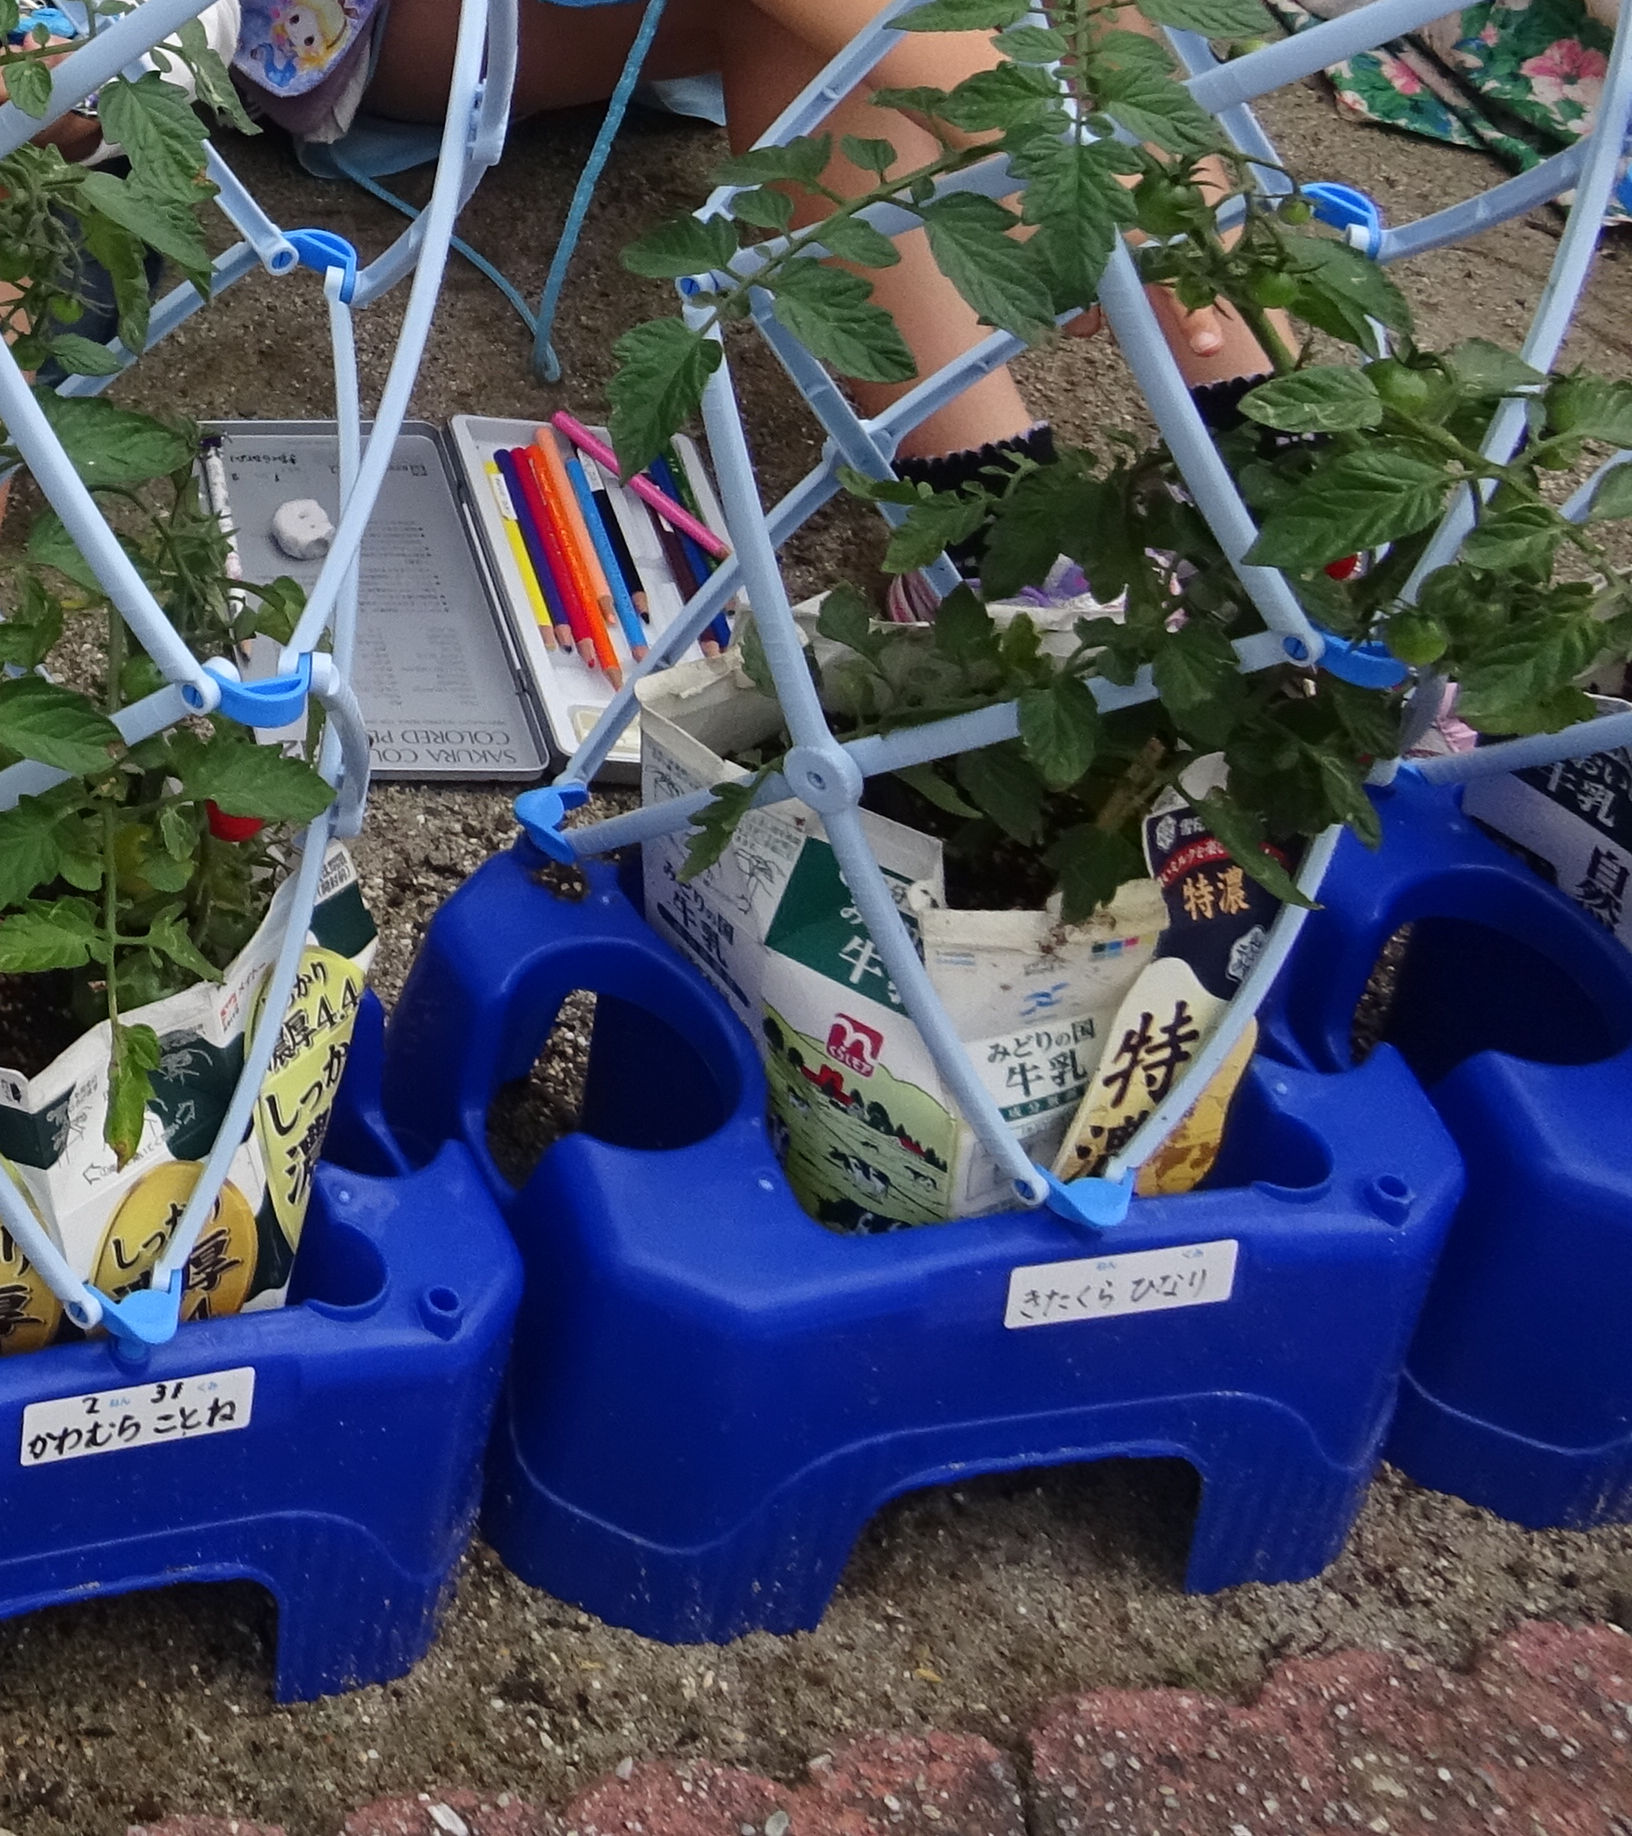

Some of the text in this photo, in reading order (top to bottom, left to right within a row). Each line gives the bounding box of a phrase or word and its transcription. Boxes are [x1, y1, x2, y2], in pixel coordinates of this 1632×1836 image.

[400, 730, 510, 746] COLORED
[425, 749, 517, 764] SAKURA
[1182, 865, 1251, 922] 特濃
[987, 1017, 1095, 1063] みどりの国
[1005, 1049, 1088, 1098] 牛乳
[1020, 1268, 1207, 1320] きたくら ひなり
[27, 1397, 237, 1460] かわむら ことね
